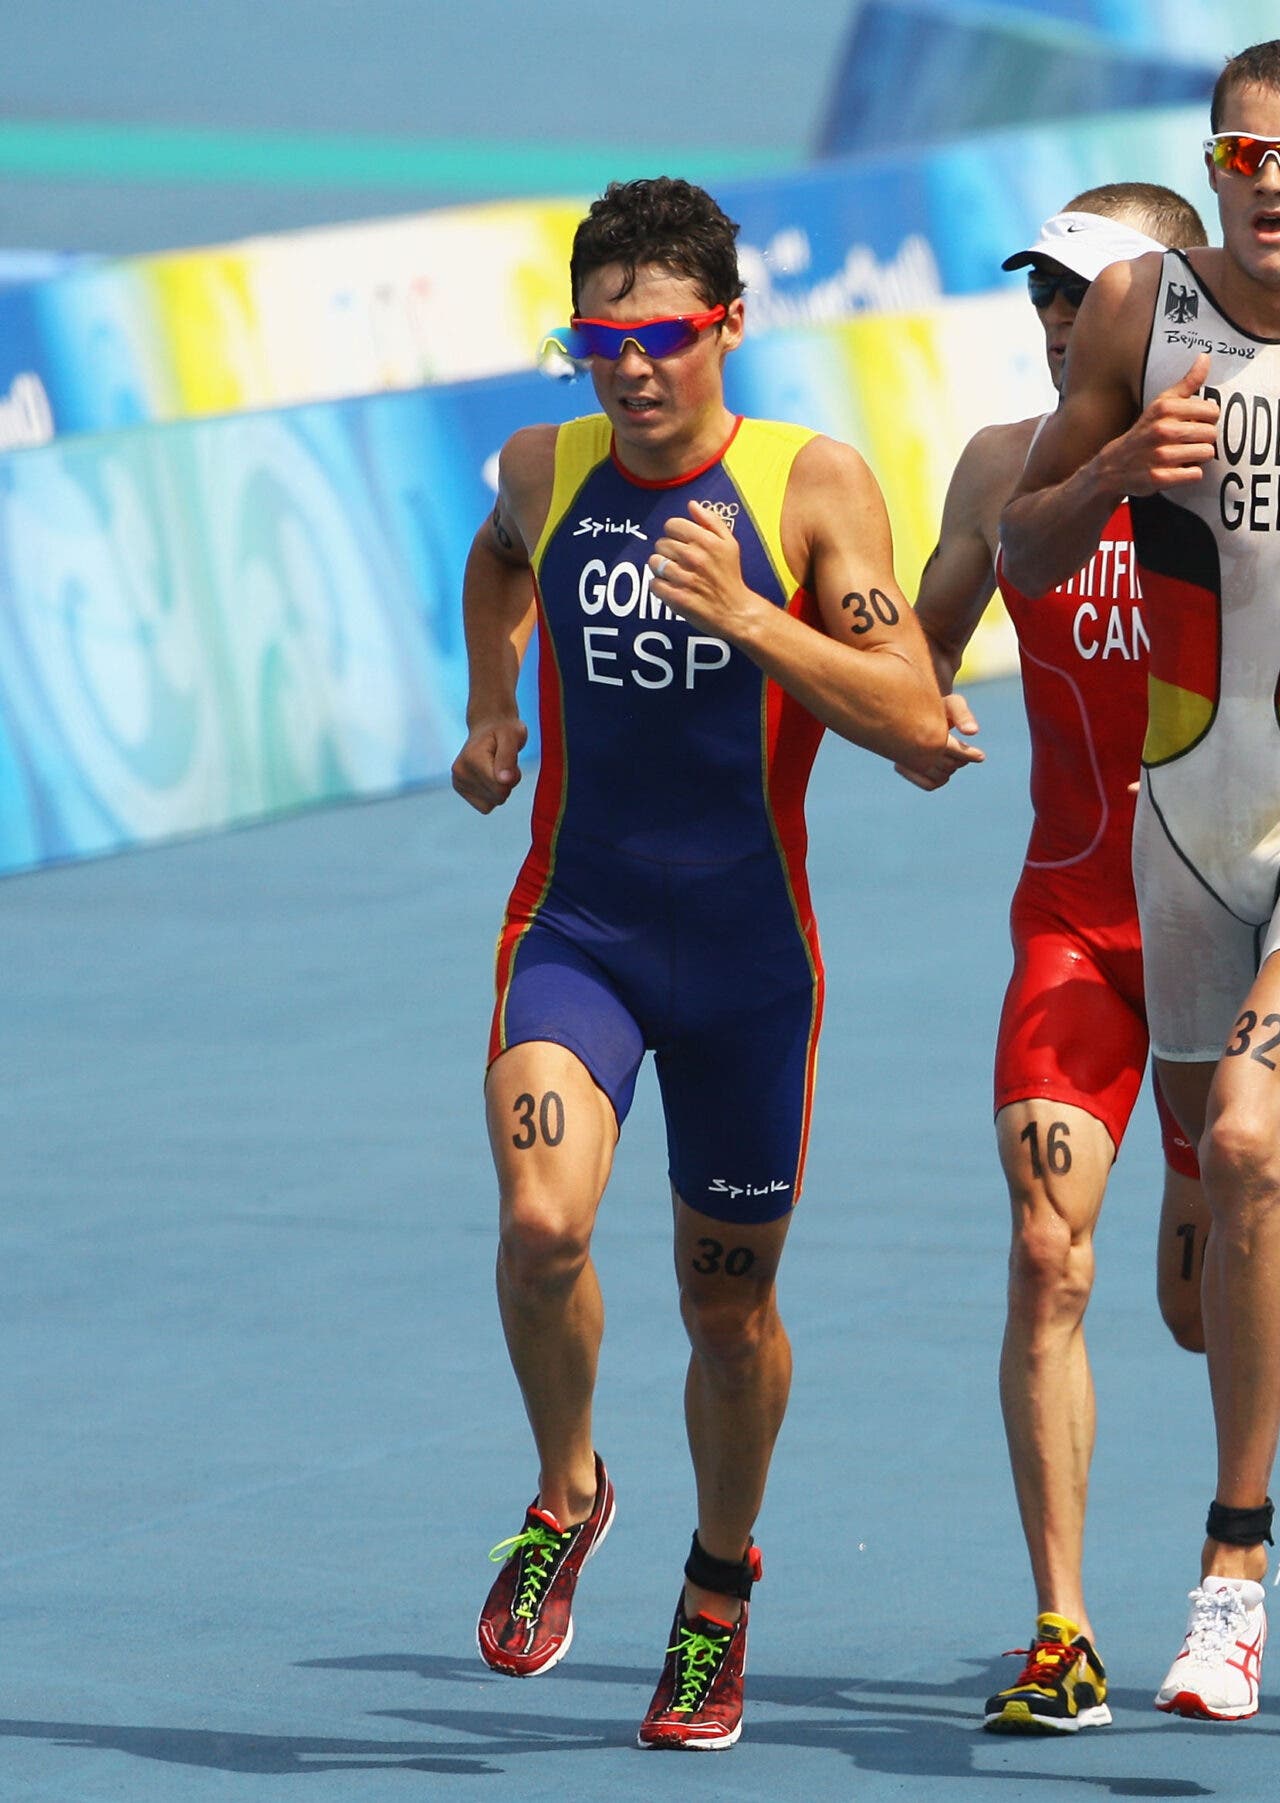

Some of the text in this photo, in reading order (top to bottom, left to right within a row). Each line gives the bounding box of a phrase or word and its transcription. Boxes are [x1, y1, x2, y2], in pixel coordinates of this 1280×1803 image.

[1164, 331, 1256, 360] Beijing 2008
[578, 558, 687, 622] GOM
[842, 588, 900, 635] 30
[583, 626, 731, 690] ESP
[512, 1090, 565, 1150] 30
[1020, 1120, 1072, 1179] 16
[692, 1237, 757, 1277] 30
